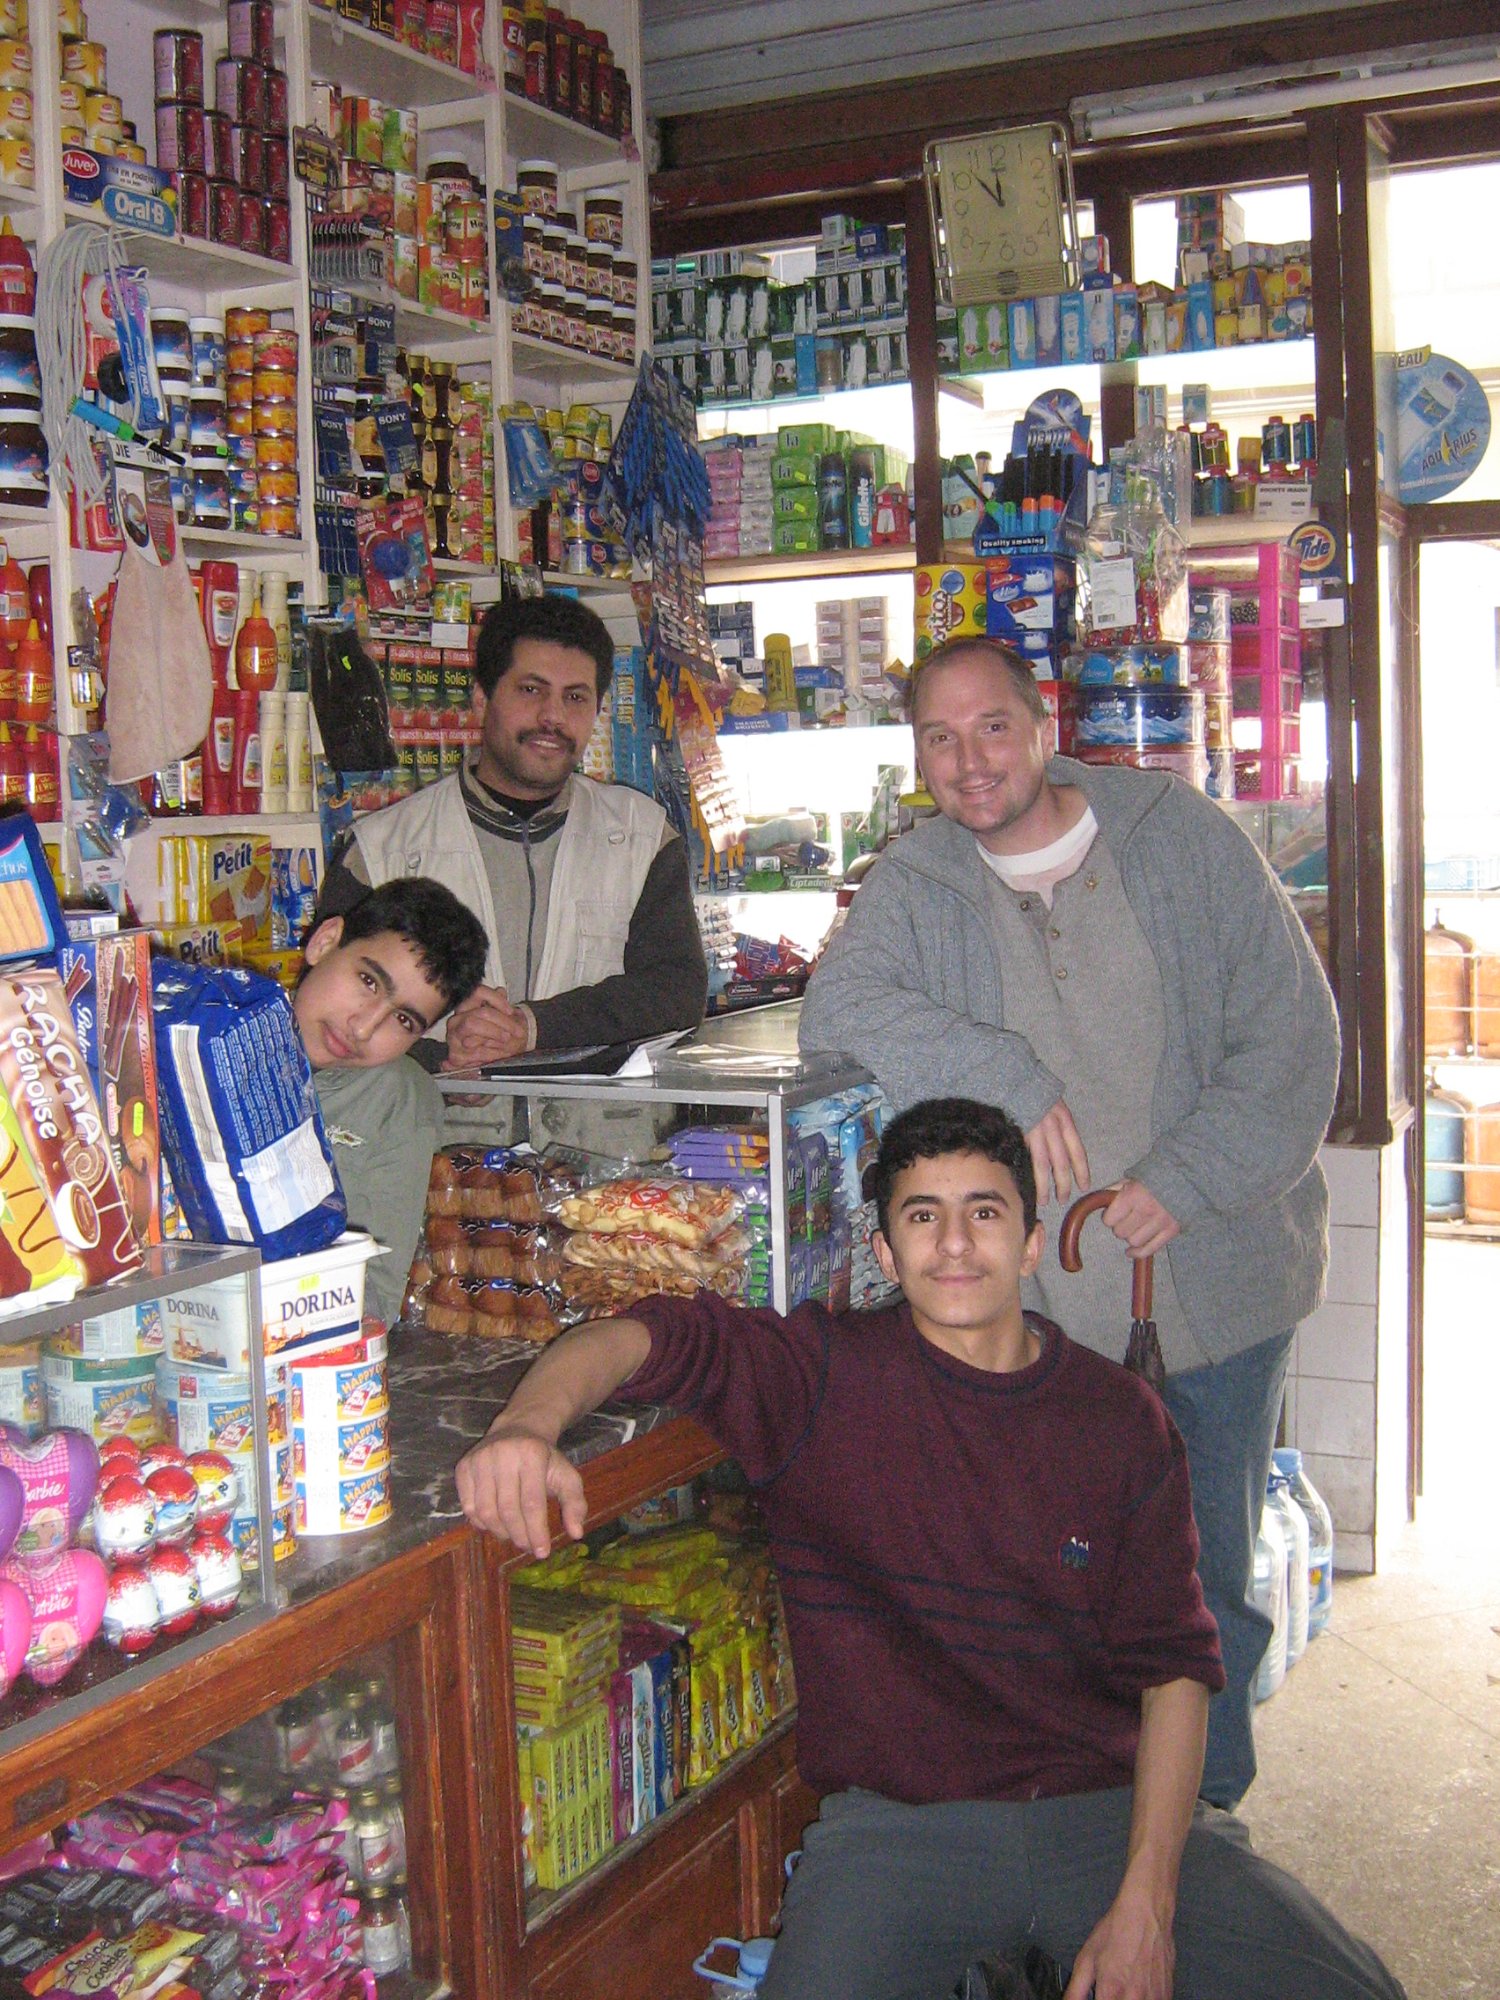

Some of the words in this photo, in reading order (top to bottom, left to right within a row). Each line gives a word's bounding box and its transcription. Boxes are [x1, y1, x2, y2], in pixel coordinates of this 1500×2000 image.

[63, 153, 97, 173] Juver
[367, 316, 393, 330] SONY
[320, 418, 344, 431] SONY
[377, 411, 408, 426] SONY
[115, 442, 131, 459] JIE
[857, 477, 869, 528] Gillette
[982, 540, 1010, 551] Quality
[1011, 537, 1045, 549] smoking
[1295, 534, 1332, 562] Tide
[390, 667, 413, 683] Solis
[415, 669, 439, 685] Solis
[444, 670, 467, 686] Solis
[416, 750, 439, 765] Solis
[212, 842, 253, 882] Petit
[179, 929, 220, 964] Petit
[20, 984, 101, 1147] RACHA
[9, 1026, 59, 1141] Génoise
[166, 1297, 220, 1322] DORINA
[280, 1284, 356, 1322] DORINA
[341, 1366, 375, 1396] HAPPY
[342, 1420, 377, 1449] HAPPY
[343, 1474, 378, 1504] HAPPY
